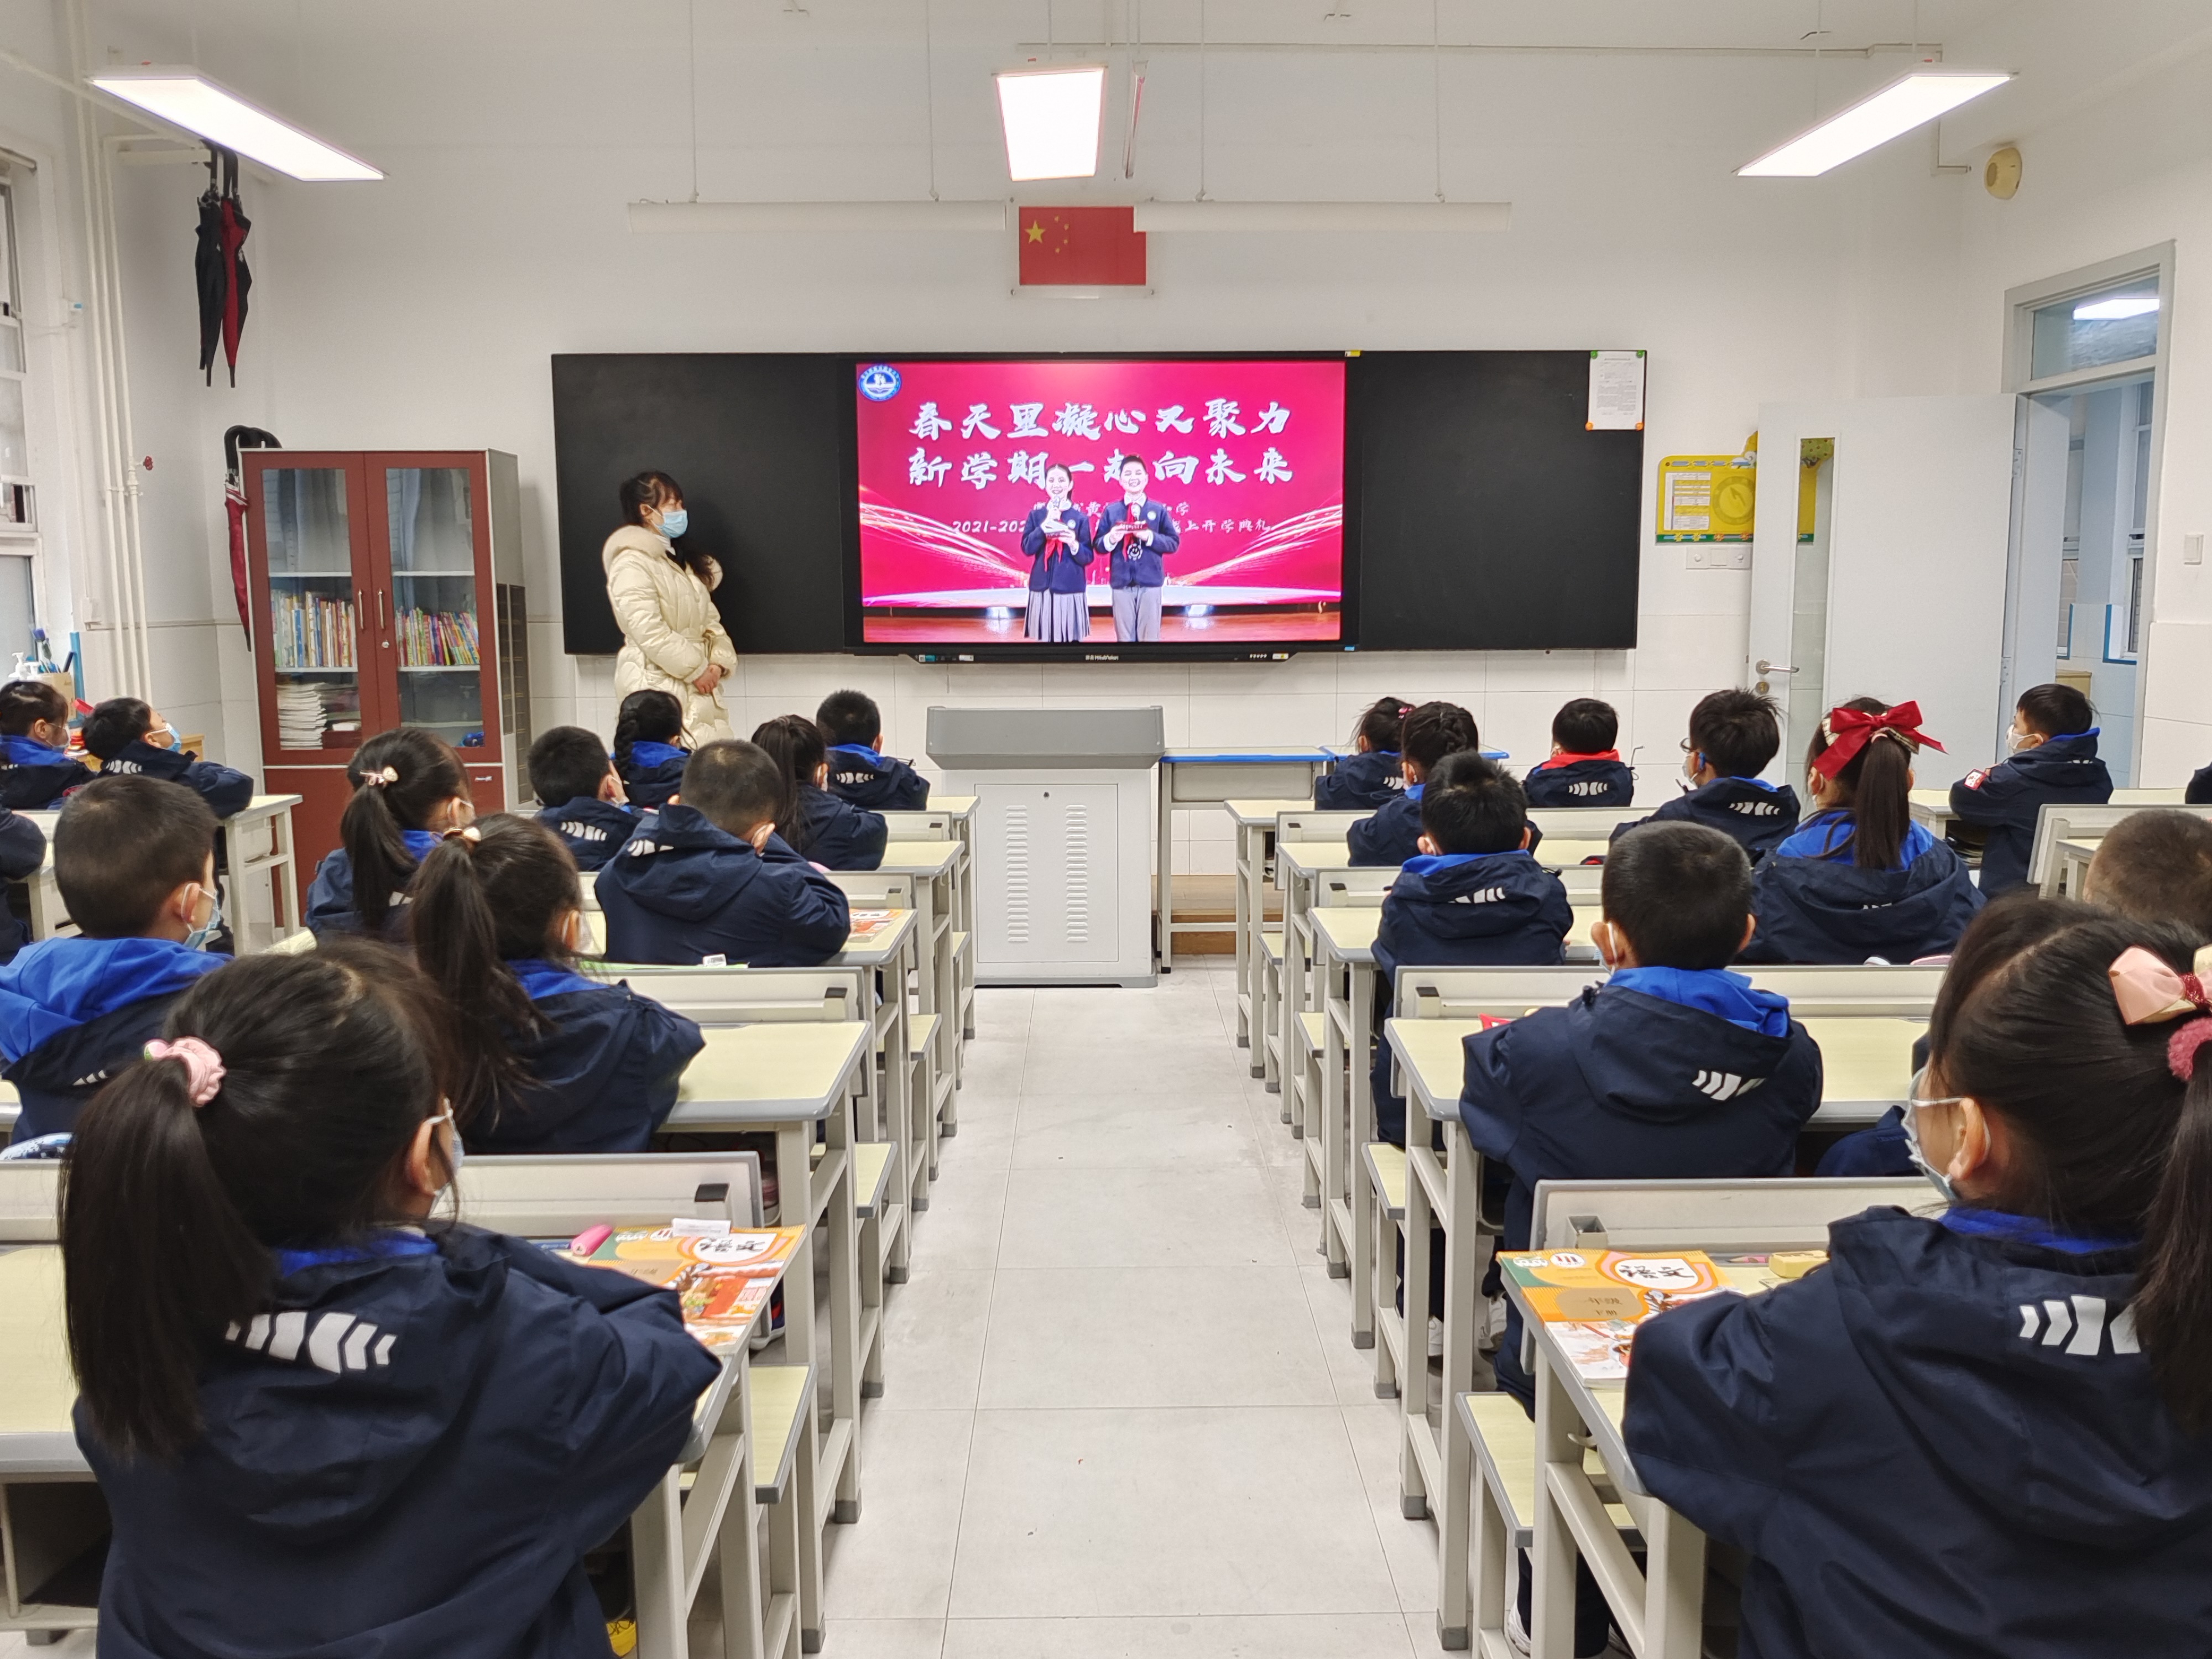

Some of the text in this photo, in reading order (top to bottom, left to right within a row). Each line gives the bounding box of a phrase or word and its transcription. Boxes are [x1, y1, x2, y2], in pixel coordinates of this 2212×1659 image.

[909, 398, 1290, 441] 春天里凝心又聚力
[1618, 1264, 1695, 1278] 语文
